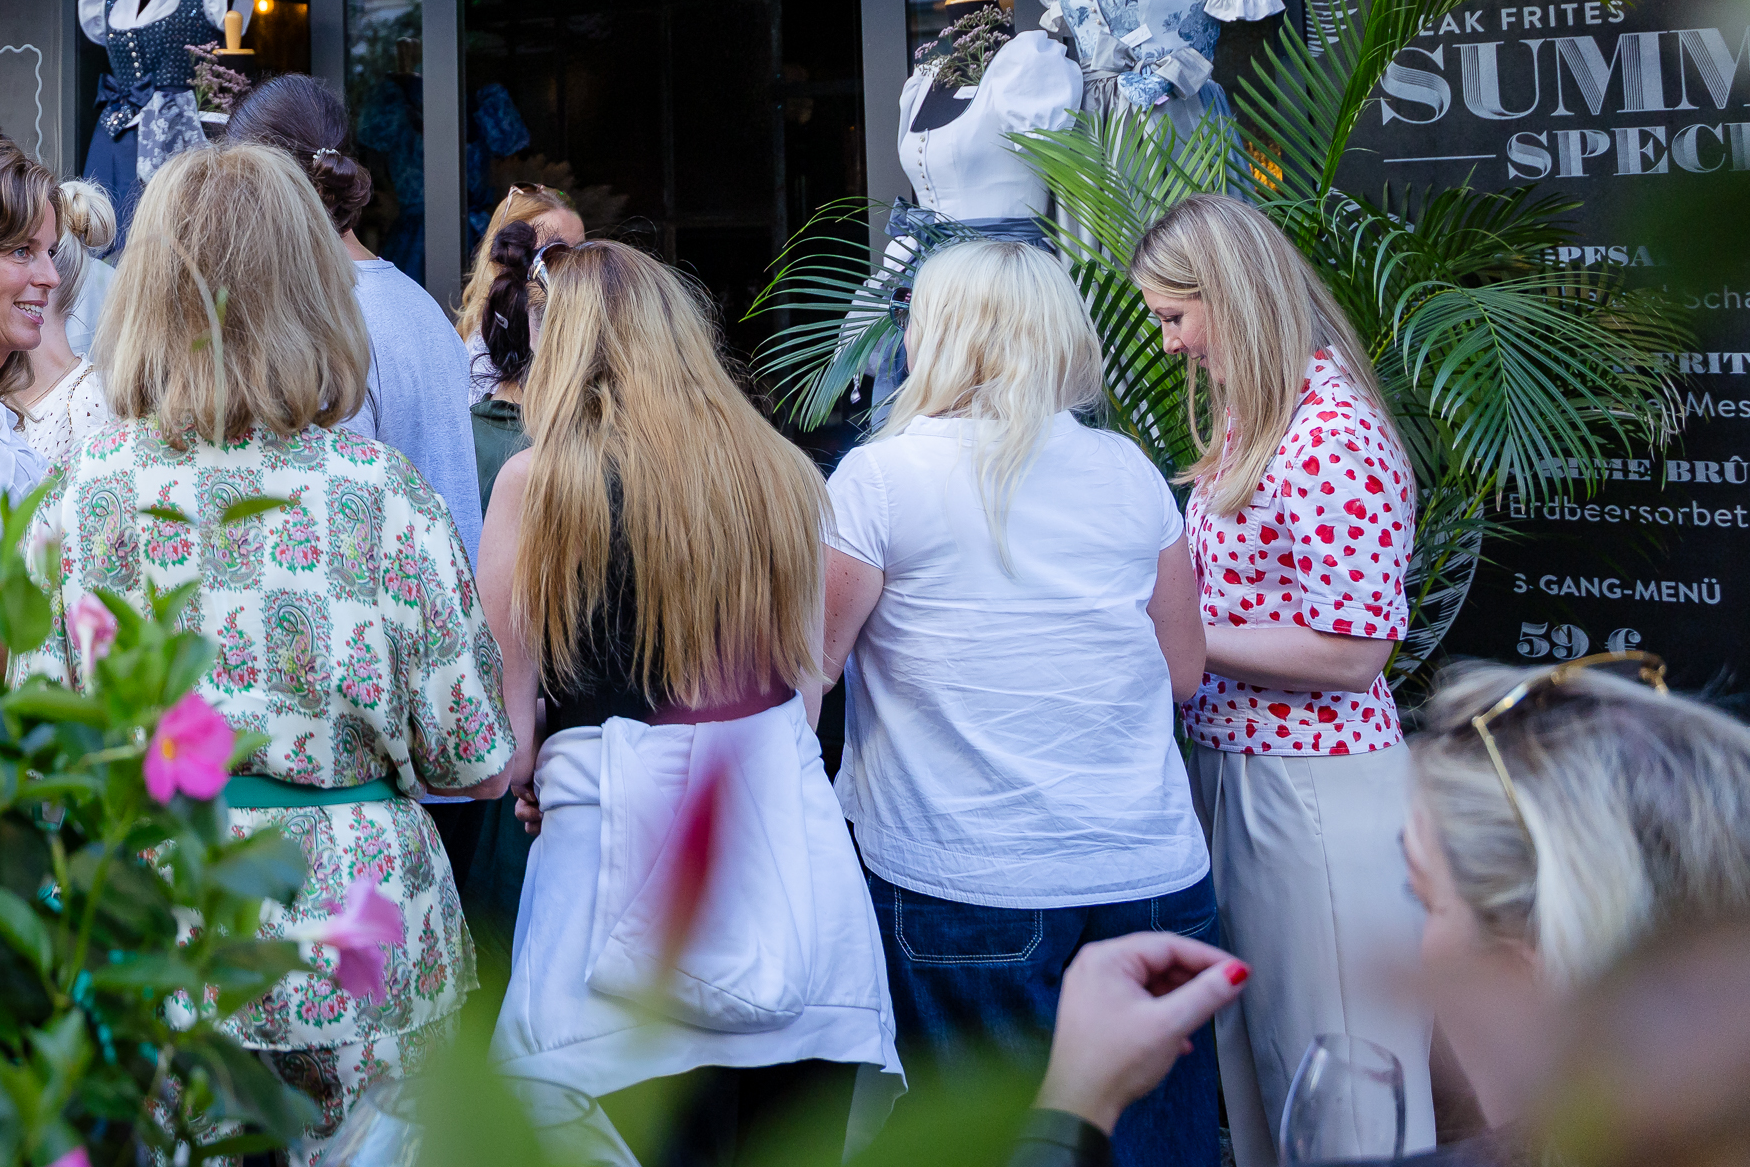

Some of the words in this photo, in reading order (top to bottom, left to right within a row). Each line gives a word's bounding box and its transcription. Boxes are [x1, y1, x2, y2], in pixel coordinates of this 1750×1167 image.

[1416, 10, 1485, 36] EAK
[1500, 0, 1626, 31] FRITES
[1665, 454, 1749, 485] BRÛ
[1509, 493, 1750, 529] Erdbeersorbet
[1516, 621, 1590, 661] 59
[1604, 626, 1642, 659] €
